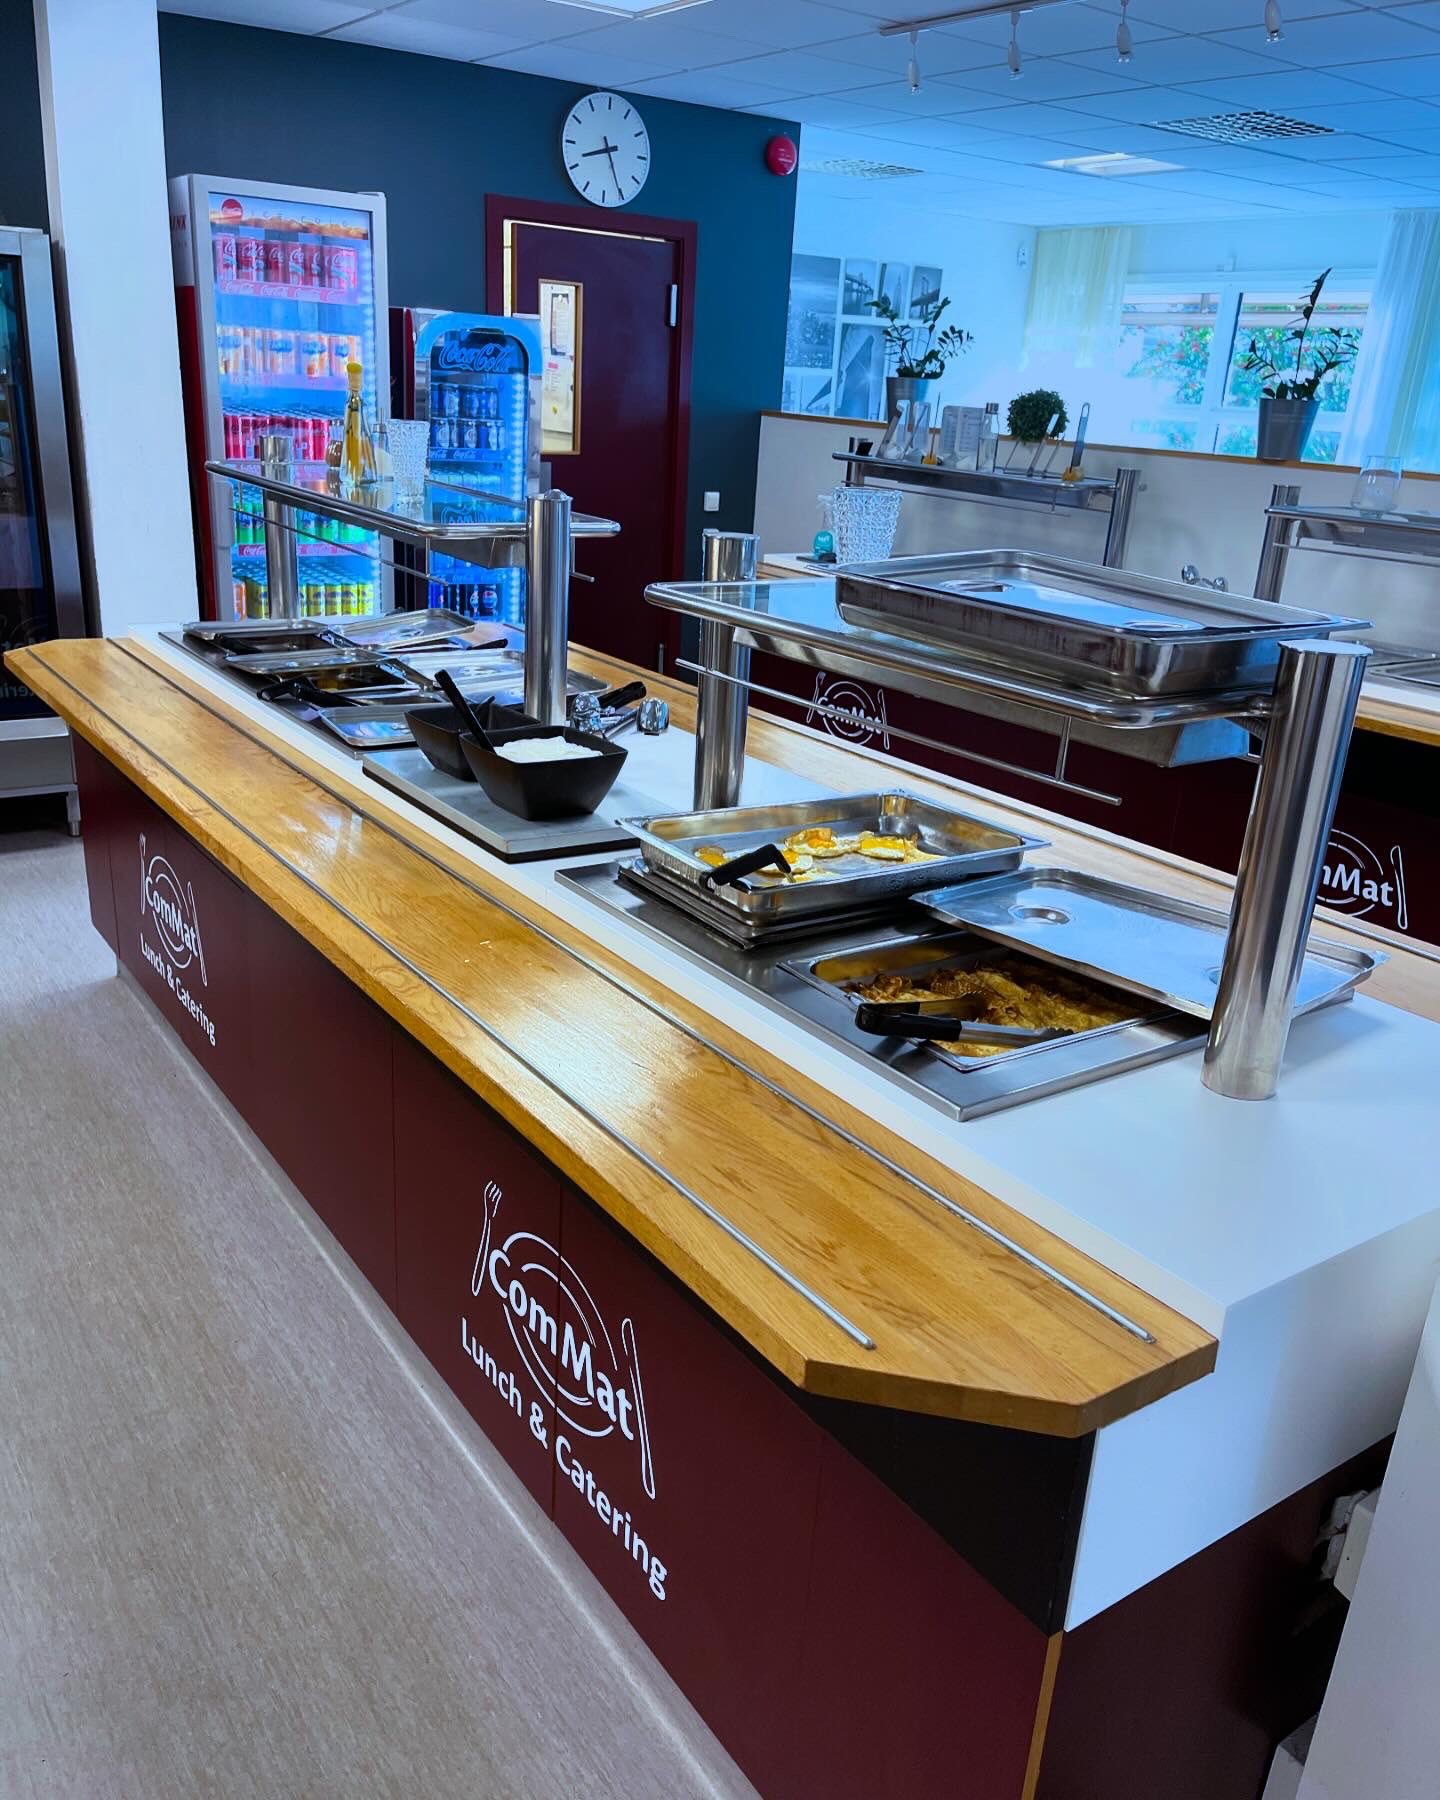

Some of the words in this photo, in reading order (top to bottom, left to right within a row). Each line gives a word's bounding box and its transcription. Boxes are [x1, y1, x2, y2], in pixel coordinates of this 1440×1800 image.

[145, 876, 199, 957] ComMat
[1321, 863, 1393, 907] Mat
[140, 932, 166, 978] Lunch
[166, 964, 176, 992] &
[175, 977, 216, 1047] Catering
[488, 1249, 635, 1441] ComMat
[462, 1317, 523, 1417] Lunch
[529, 1401, 549, 1450] &
[555, 1435, 668, 1601] Catering
